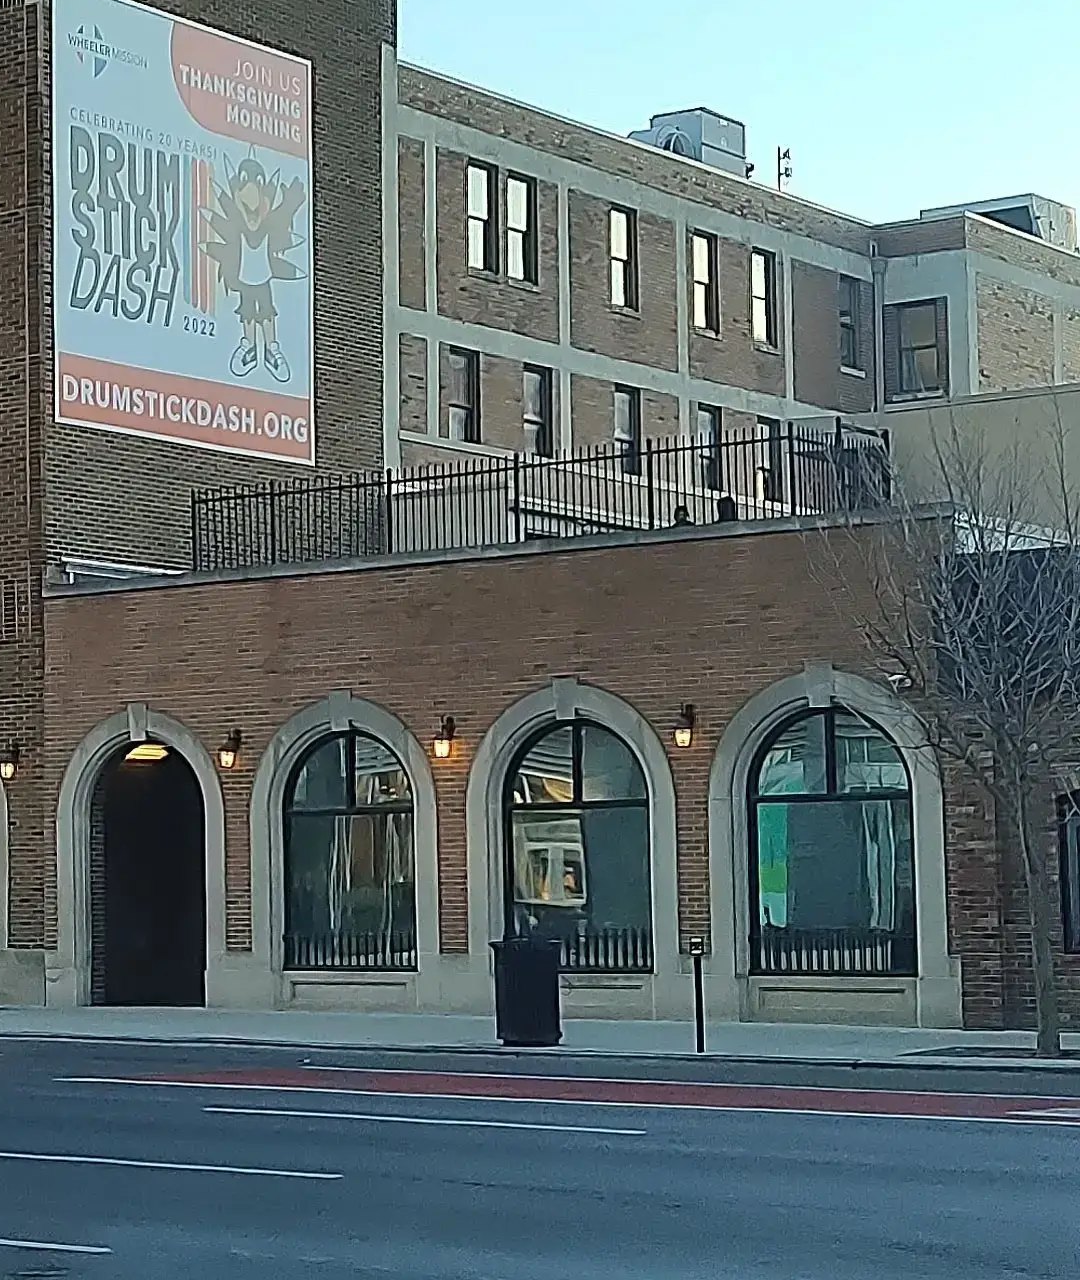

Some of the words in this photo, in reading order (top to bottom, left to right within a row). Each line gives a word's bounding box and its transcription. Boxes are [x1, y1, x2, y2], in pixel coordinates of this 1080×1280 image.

[67, 33, 111, 58] WHEELER
[112, 47, 148, 69] MISSION
[179, 63, 301, 119] THANKSGIVING
[233, 58, 273, 88] JOIN
[279, 75, 301, 96] US
[69, 107, 154, 143] CELEBRATING
[158, 131, 172, 147] 20
[226, 104, 301, 144] MORNING
[70, 124, 180, 208] DRUM
[71, 188, 180, 272] STICK
[70, 247, 180, 327] DASH
[183, 315, 216, 337] 2022
[61, 374, 308, 443] DRUMSTICKDASH.ORG
